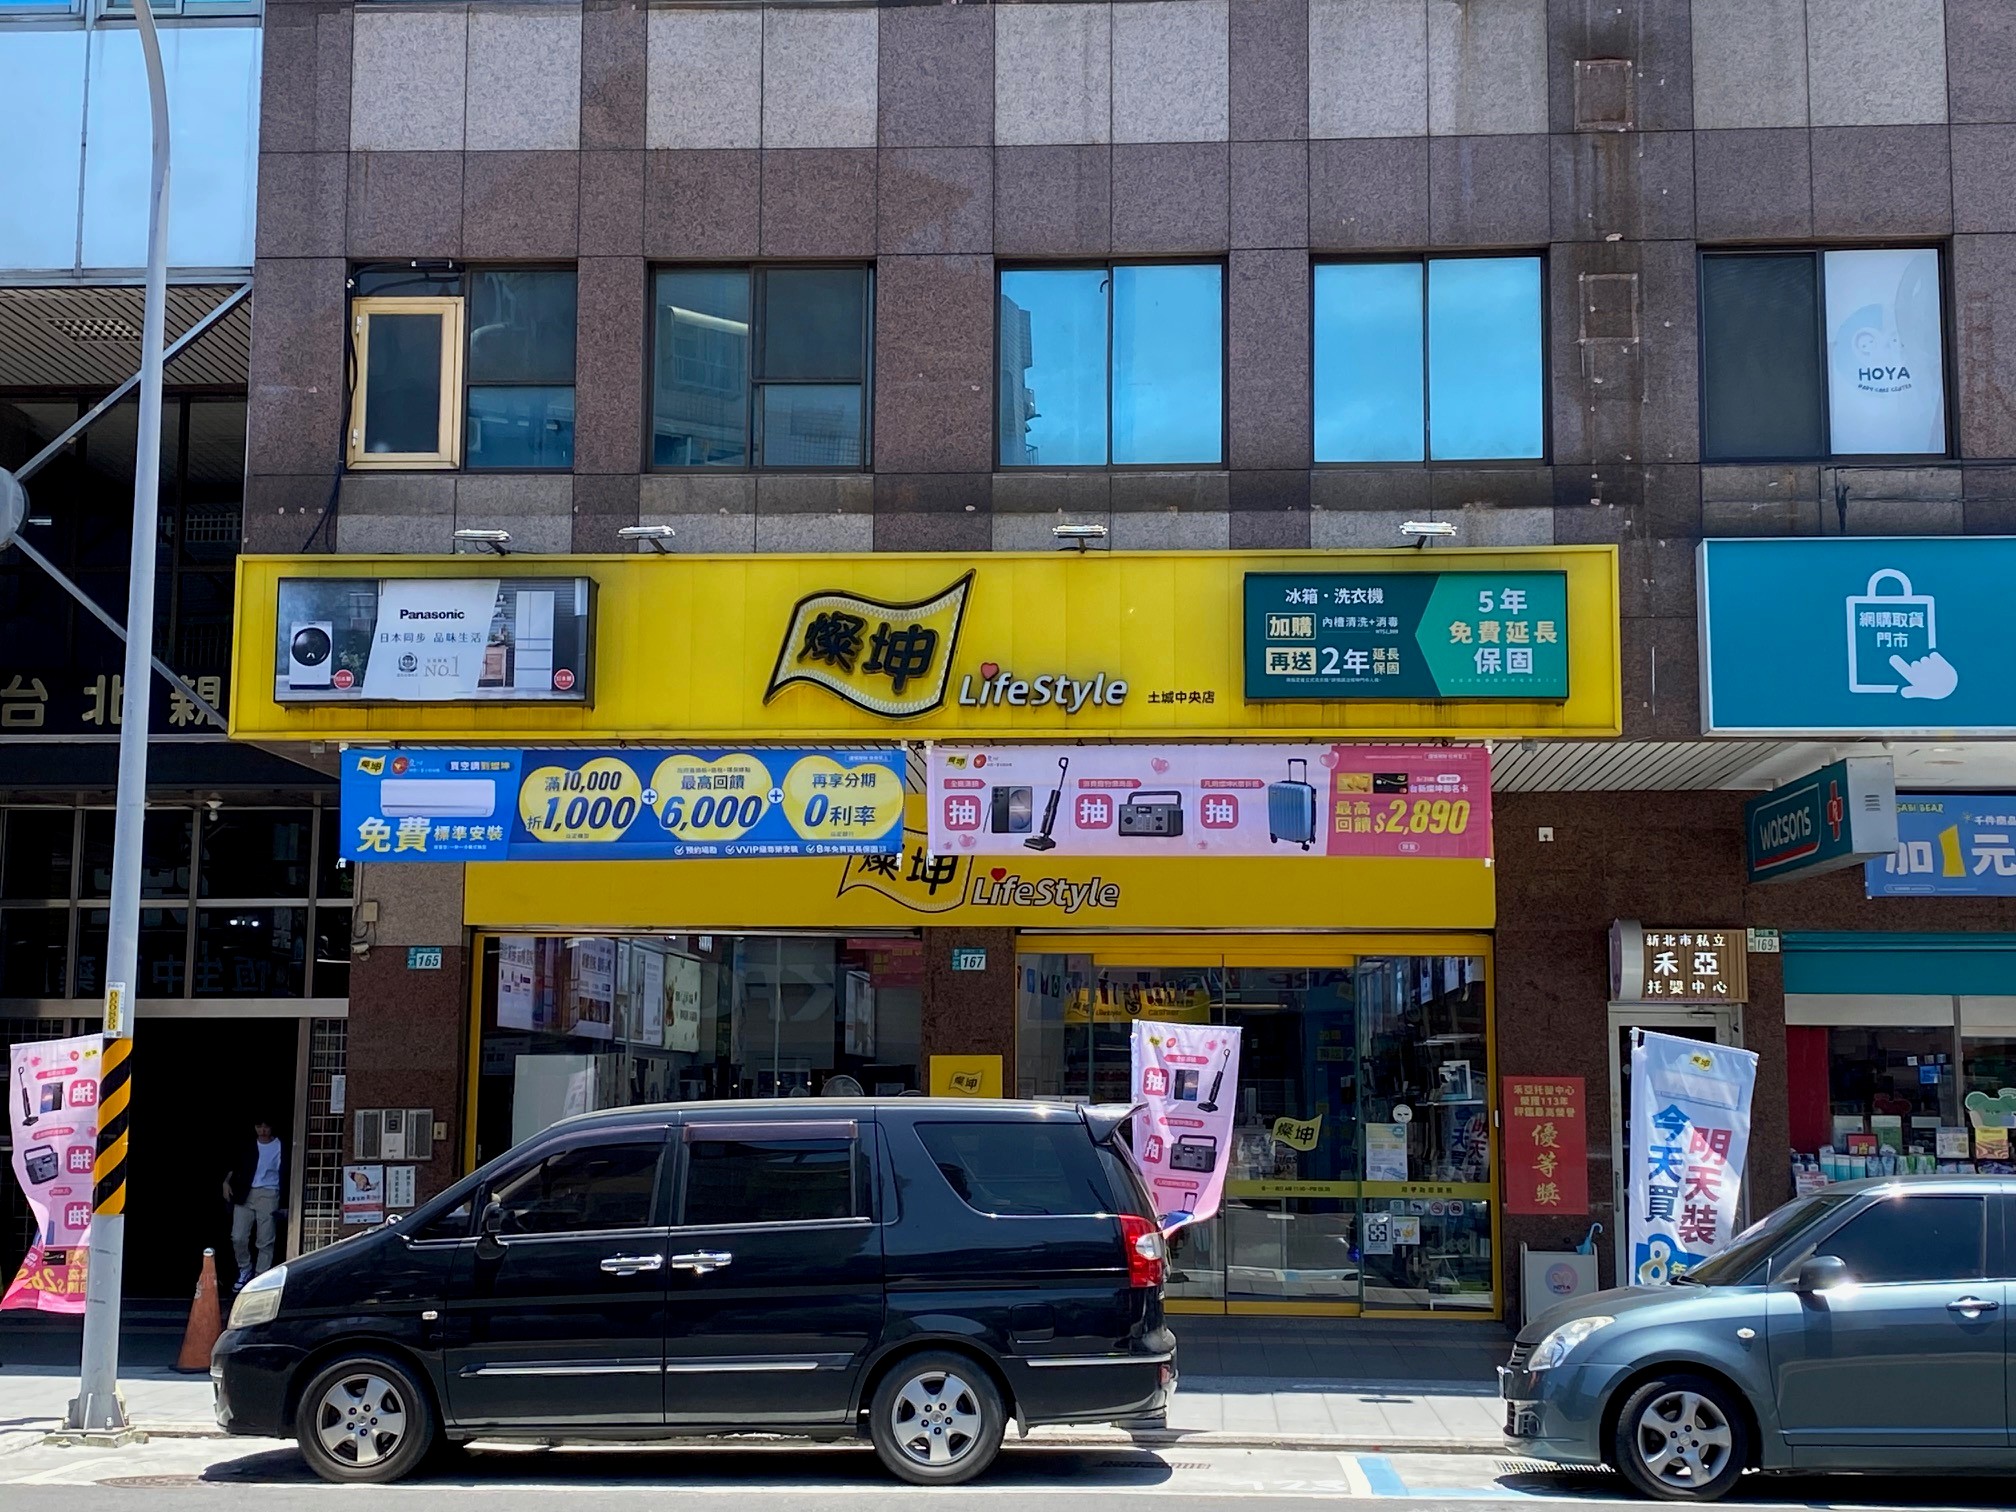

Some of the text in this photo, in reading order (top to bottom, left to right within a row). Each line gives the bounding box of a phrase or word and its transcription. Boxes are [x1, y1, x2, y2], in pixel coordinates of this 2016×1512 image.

[1859, 366, 1910, 381] HOYA
[399, 608, 465, 621] Panasonic
[1859, 611, 1924, 628] 網購取貨
[380, 632, 482, 644] 日本同步 品味生活
[1269, 615, 1313, 638] 加購
[1449, 620, 1558, 645] 免費延長
[1876, 632, 1909, 649] 門市
[797, 610, 938, 695] 燦坤
[1269, 650, 1313, 672] 再送
[1321, 646, 1370, 675] 2年
[1372, 647, 1400, 661] 延長
[1474, 647, 1534, 675] 保固
[1372, 662, 1400, 675] 保固
[958, 670, 1129, 714] LifeStyle
[1147, 690, 1215, 705] 土城中央店
[681, 774, 745, 790] 最高回饋
[812, 773, 876, 788] 再享分期
[660, 795, 763, 832] 6,000
[804, 794, 876, 828] 0利率
[949, 799, 976, 825] 抽
[1080, 799, 1108, 824] 抽
[1205, 799, 1234, 824] 抽
[1335, 800, 1371, 815] 最高
[1335, 799, 1470, 835] 回饋 $2,890
[357, 816, 432, 853] 免費
[434, 825, 504, 842] 標準安裝
[1760, 806, 1811, 851] watsons
[971, 875, 1120, 914] LifeStyle
[1647, 934, 1726, 946] 新北市私立
[1757, 938, 1773, 951] 169
[419, 954, 439, 967] 165
[963, 956, 983, 968] 167
[1654, 951, 1720, 976] 禾亞
[1647, 980, 1728, 994] 托嬰中心
[1145, 1071, 1168, 1093] 抽
[1276, 1121, 1314, 1145] 燦坤
[1531, 1122, 1561, 1206] 優等獎
[1644, 1104, 1690, 1223] 今天買
[1678, 1127, 1732, 1246] 明天裝
